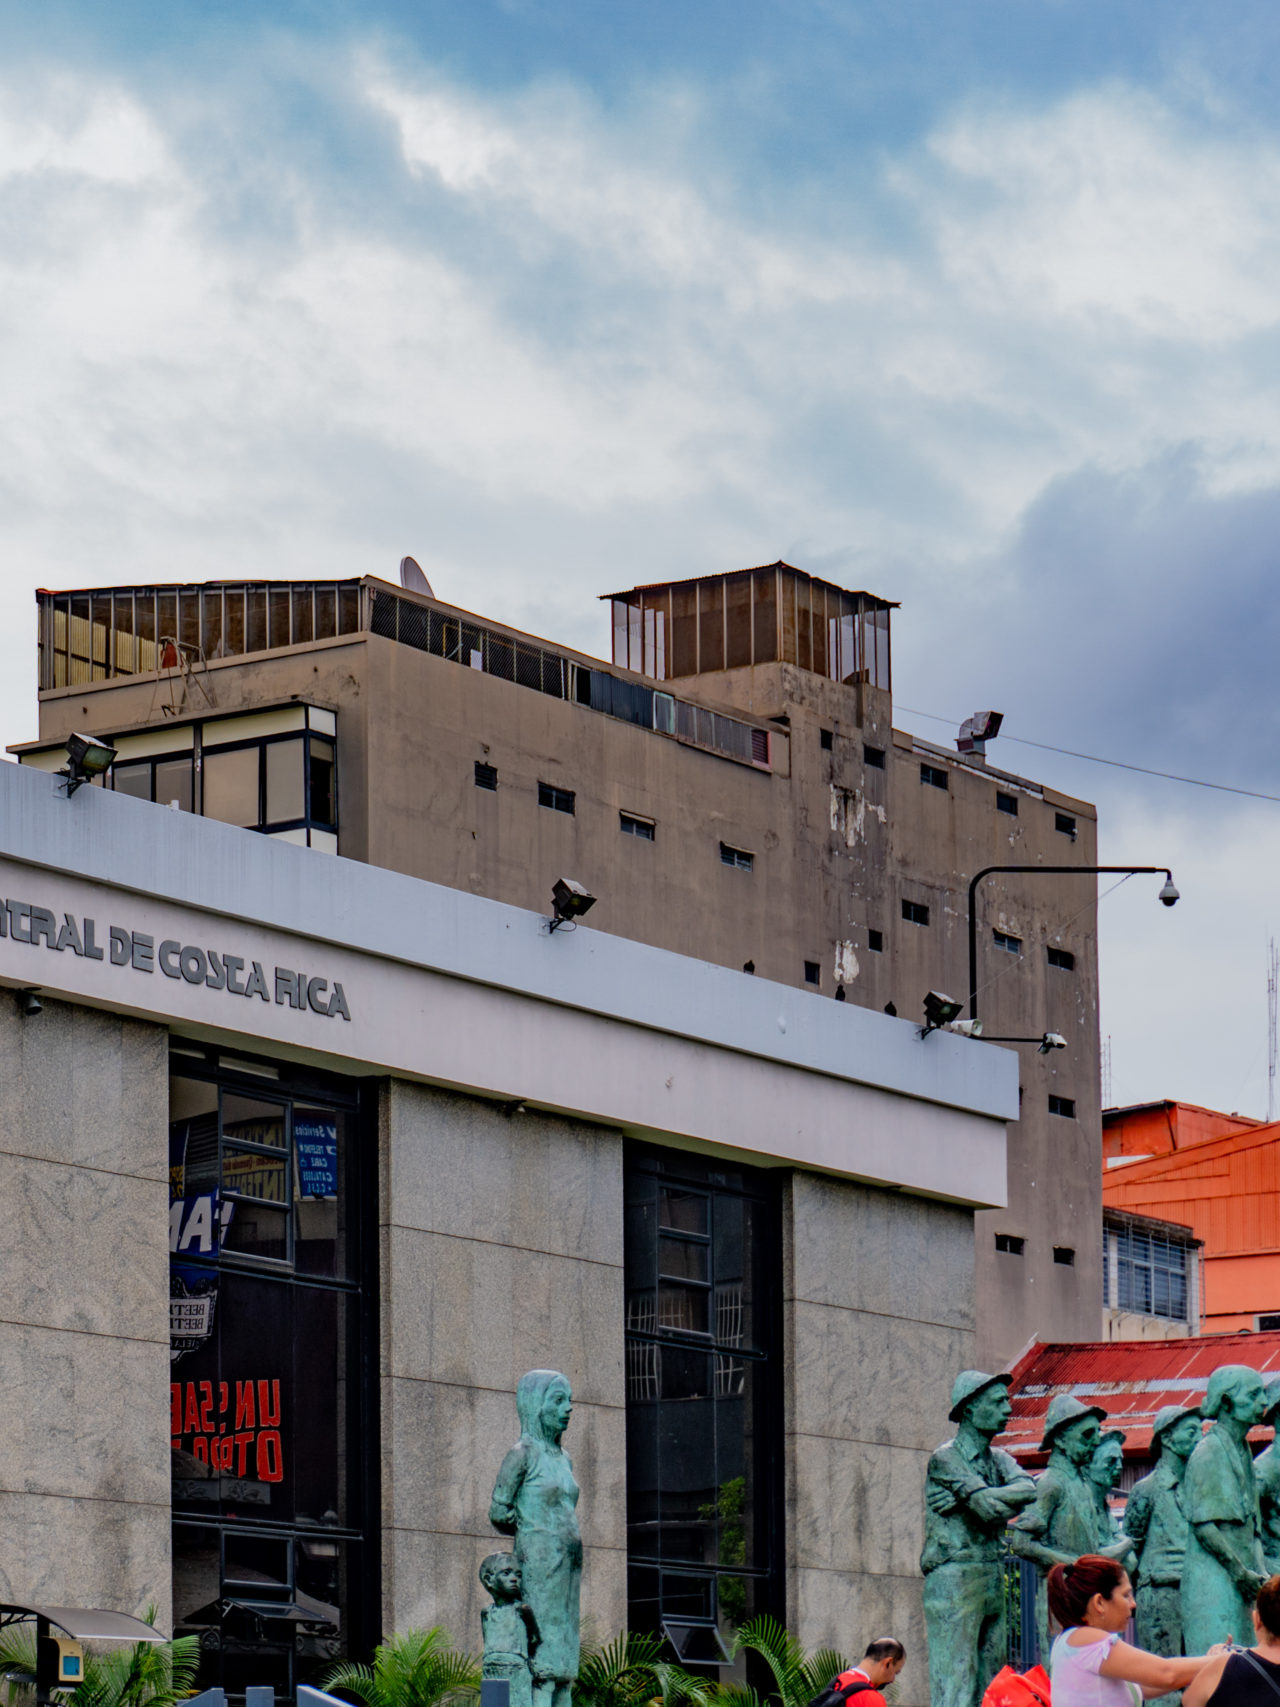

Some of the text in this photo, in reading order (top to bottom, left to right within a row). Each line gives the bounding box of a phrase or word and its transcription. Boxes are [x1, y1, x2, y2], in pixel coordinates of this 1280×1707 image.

[110, 925, 154, 973] DE
[158, 939, 270, 1002] COSTA
[275, 966, 351, 1021] RICA
